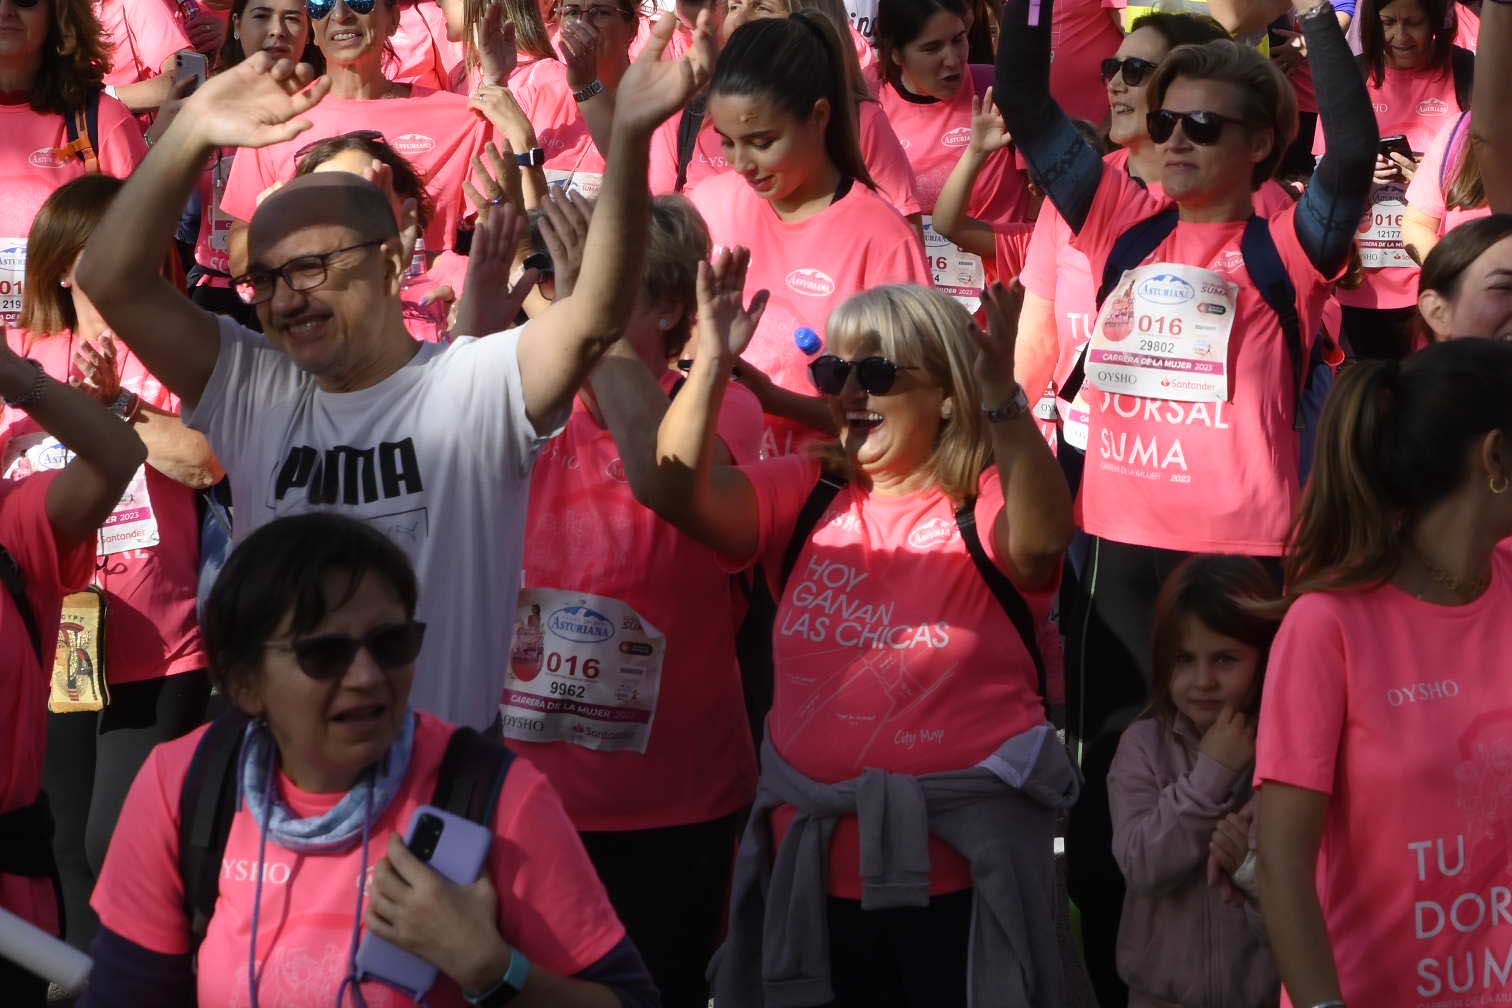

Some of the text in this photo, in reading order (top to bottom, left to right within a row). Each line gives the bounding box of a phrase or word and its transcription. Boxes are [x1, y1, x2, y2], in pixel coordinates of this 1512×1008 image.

[789, 276, 832, 293] ASTURIANA
[1138, 315, 1183, 336] 016
[1139, 339, 1175, 354] 29802
[1102, 352, 1139, 365] CARRERA
[1164, 360, 1192, 370] MUJER
[1194, 362, 1214, 372] 2023
[1097, 370, 1217, 391] OYSHO Santander
[1100, 427, 1188, 472] SUMA
[275, 437, 424, 506] PUMA
[119, 511, 140, 521] 2023
[805, 554, 869, 592] HOY
[792, 581, 896, 625] GANAN
[551, 616, 609, 638] ASTURIANA
[780, 608, 951, 650] LAS CHICAS
[546, 652, 601, 679] 016
[550, 681, 586, 699] 9962
[1387, 679, 1460, 708] OYSHO
[510, 695, 610, 719] CARRERA DE LA MUJER
[1408, 835, 1465, 881] TU
